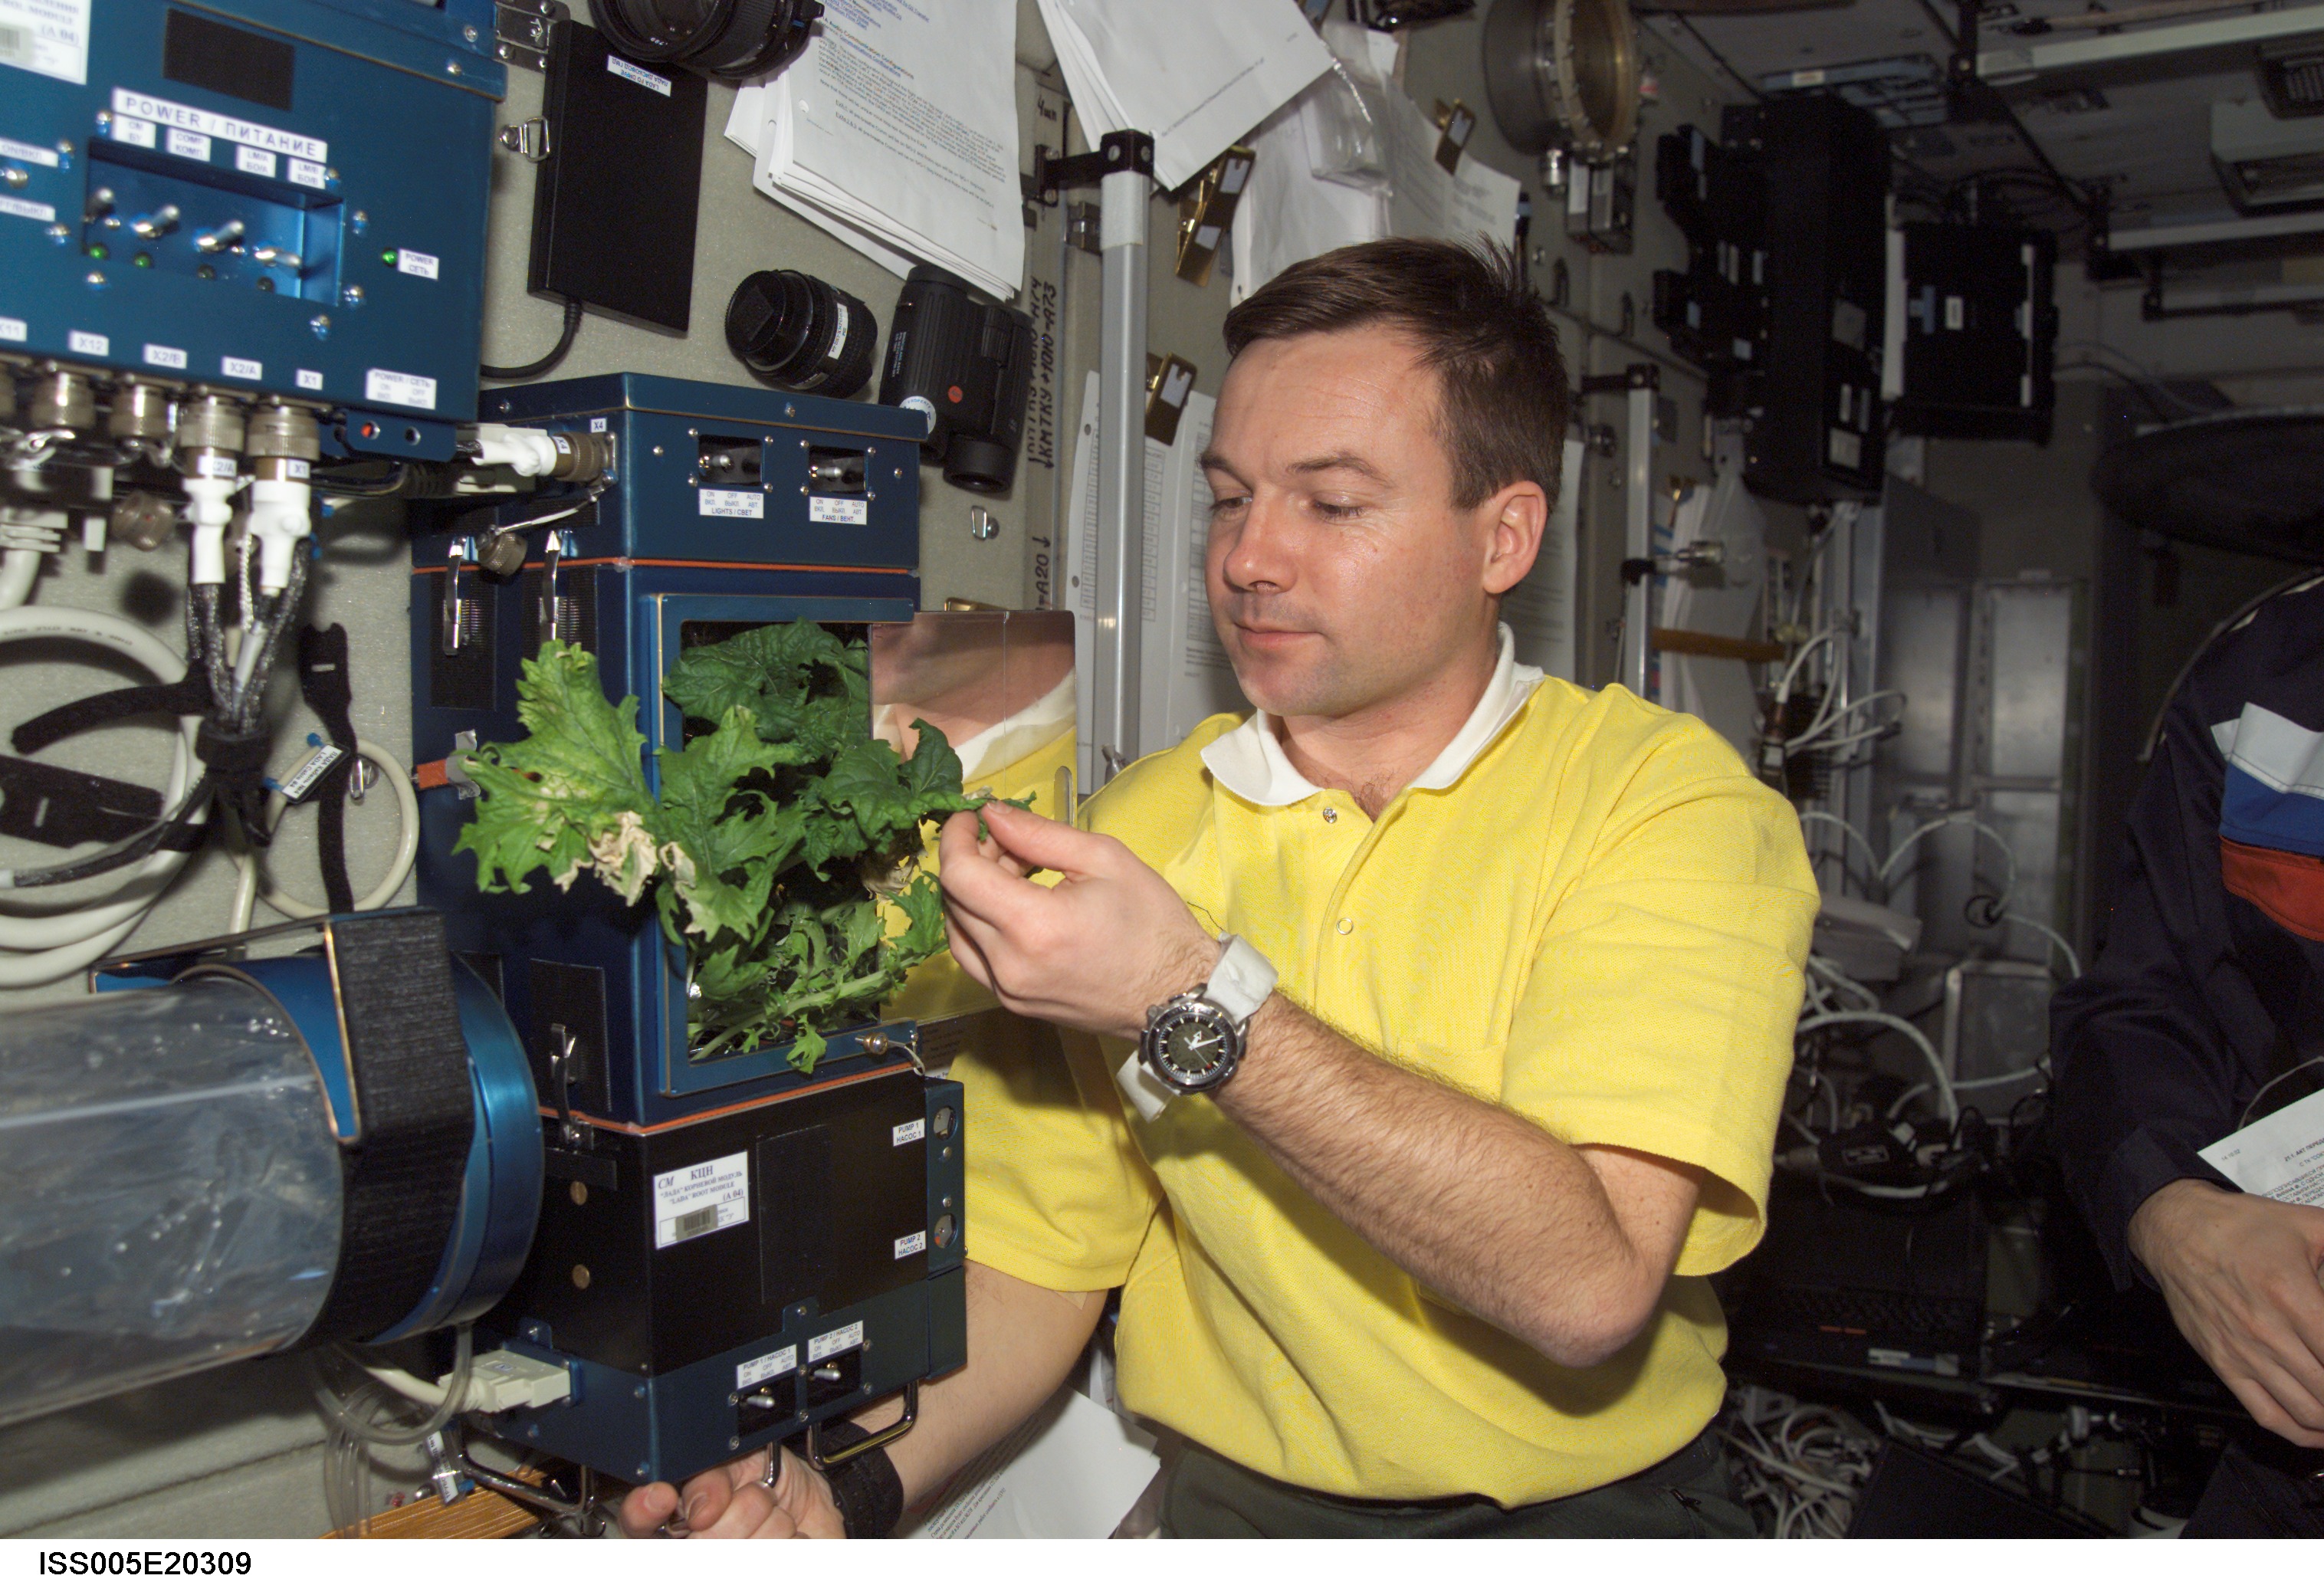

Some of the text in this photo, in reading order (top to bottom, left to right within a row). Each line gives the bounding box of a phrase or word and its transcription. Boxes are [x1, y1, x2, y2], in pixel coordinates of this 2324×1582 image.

[644, 79, 660, 91] LADA
[653, 76, 668, 87] ЛАДА
[126, 97, 200, 126] POWER
[225, 122, 317, 156] ПИТАНИЕ
[130, 133, 141, 143] БУ
[405, 253, 434, 265] POWER
[409, 264, 429, 275] СЕТЬ
[80, 337, 103, 352] X12
[153, 350, 182, 365] X2/B
[230, 363, 257, 377] X2/A
[304, 374, 317, 386] X1
[375, 372, 404, 383] POWER
[410, 376, 432, 388] СЕТЬ
[412, 388, 425, 396] OFF
[594, 422, 603, 430] X4
[557, 438, 568, 449] X4
[212, 461, 234, 474] 2/A
[295, 464, 307, 474] X1
[309, 749, 325, 767] LADA
[320, 749, 337, 768] ЛАДА
[295, 763, 313, 783] Cable
[303, 763, 324, 787] Кабель
[898, 1124, 914, 1134] PUMP
[897, 1133, 917, 1143] НАСОС
[658, 1165, 714, 1189] СМ КЦН
[661, 1171, 743, 1198] "ЛАДА" КОРНЕВОЙ МОДУЛЬ
[692, 1189, 709, 1199] ROOT
[710, 1181, 735, 1193] MODULE
[733, 1189, 743, 1198] 04)
[900, 1236, 916, 1246] PUMP
[898, 1245, 918, 1256] НАСОС
[814, 1334, 829, 1344] PUMP
[835, 1326, 854, 1337] НАСОС
[849, 1331, 861, 1340] AUTO
[743, 1360, 760, 1370] PUMP
[767, 1350, 787, 1361] НАСОС
[763, 1362, 773, 1371] OFF
[781, 1354, 794, 1364] AUTO
